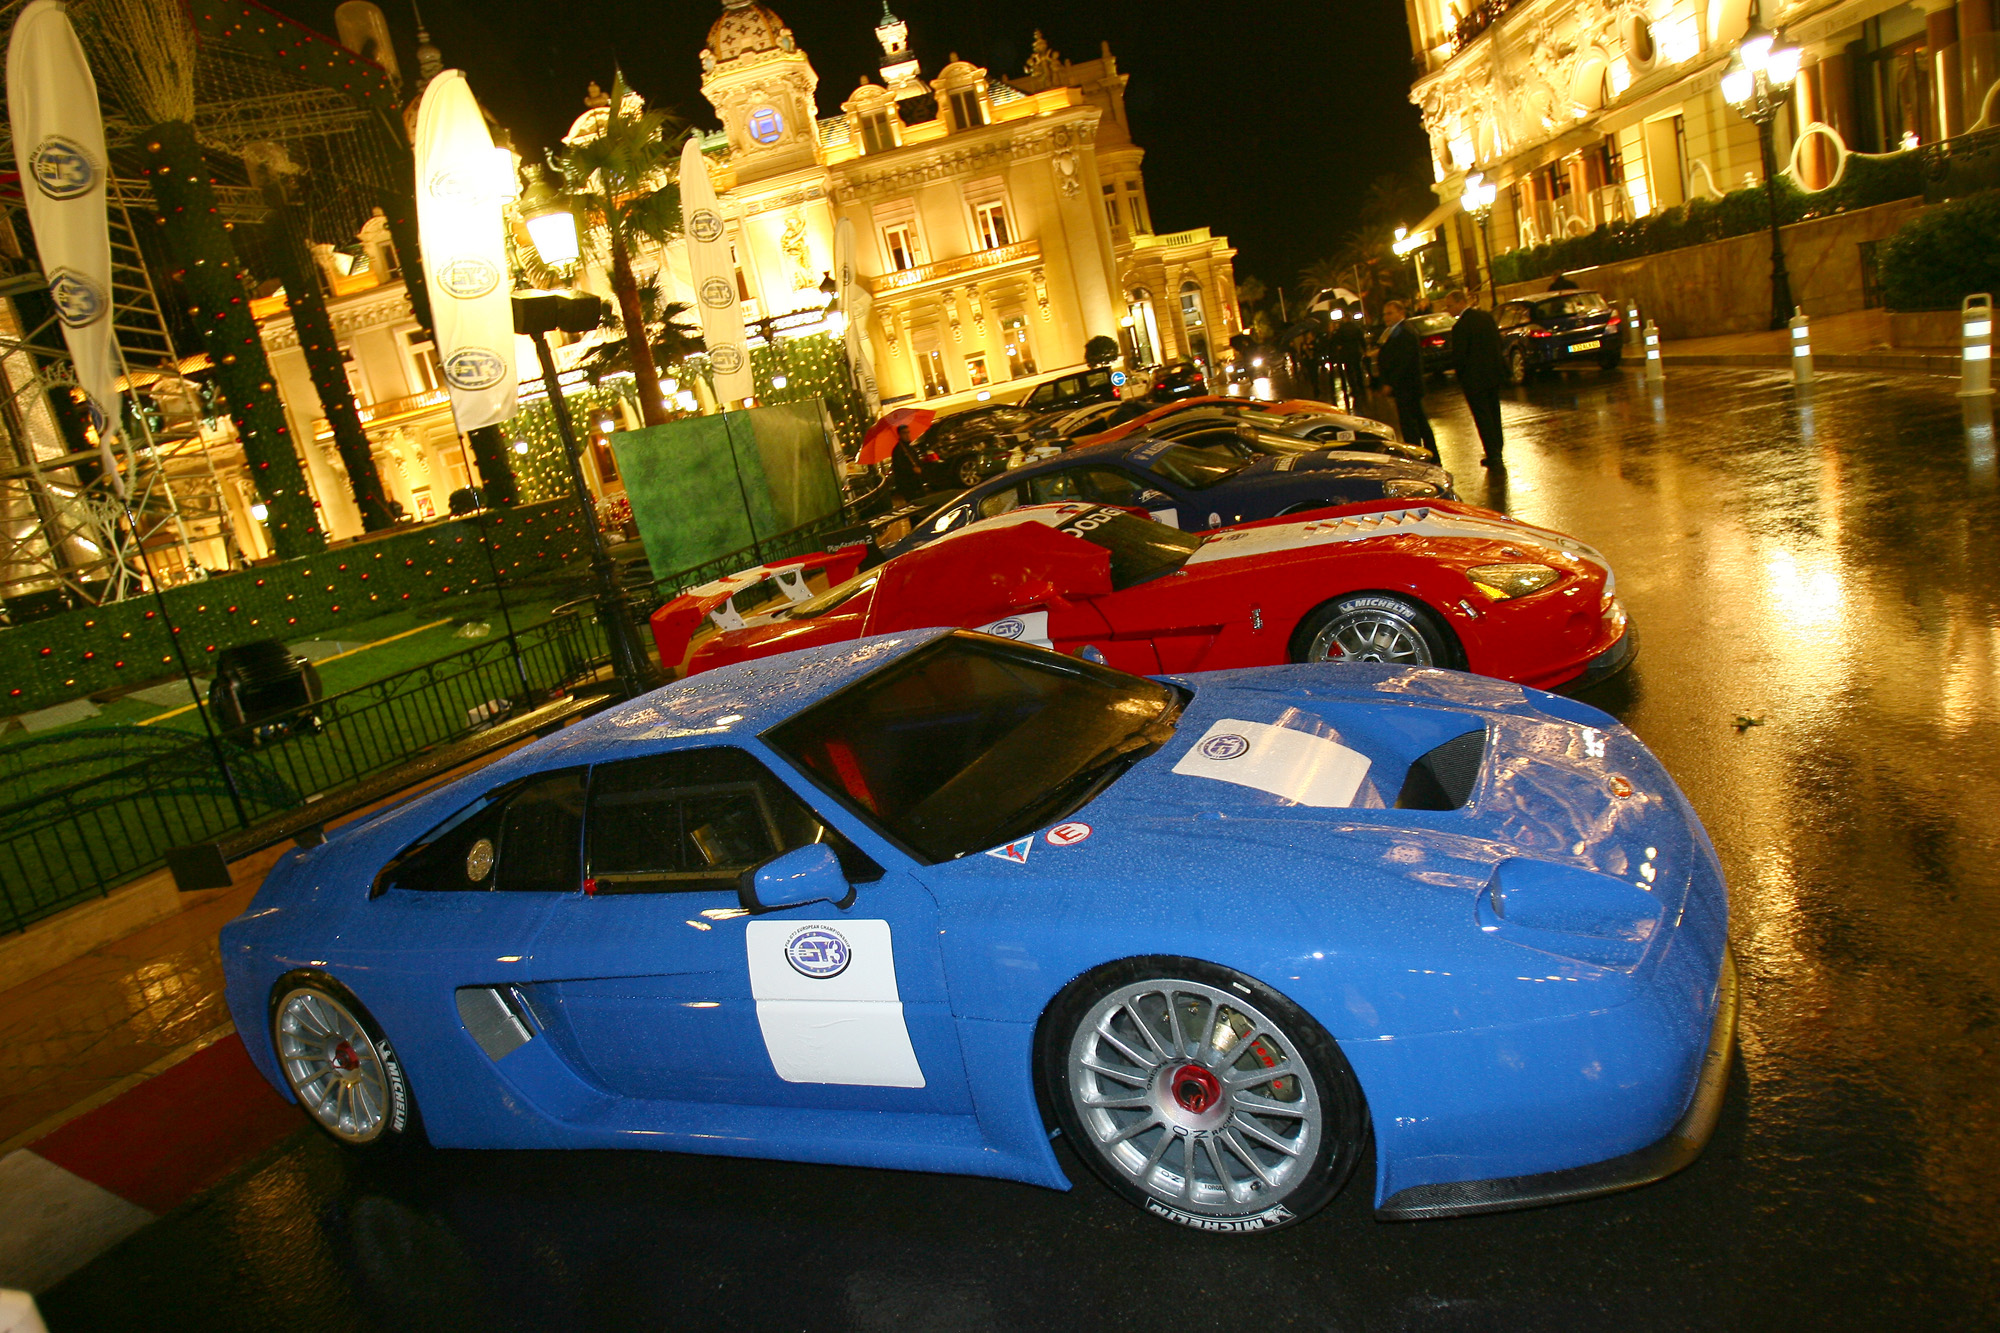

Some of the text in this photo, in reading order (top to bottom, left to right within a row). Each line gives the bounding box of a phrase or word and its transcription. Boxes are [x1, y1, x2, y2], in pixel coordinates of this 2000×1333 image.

[694, 217, 720, 233] GT3
[706, 284, 732, 300] GT3
[455, 358, 502, 378] GT3
[1354, 598, 1415, 620] MICHELIN
[995, 622, 1021, 635] GT3
[1054, 825, 1084, 841] E
[797, 924, 820, 934] EUROPEAN
[820, 924, 851, 948] CHAMPIONSHIP
[798, 940, 845, 965] GT3
[387, 1061, 406, 1132] MICHELIN
[1211, 1106, 1235, 1136] RACING
[1150, 1203, 1265, 1232] MICHELIN
